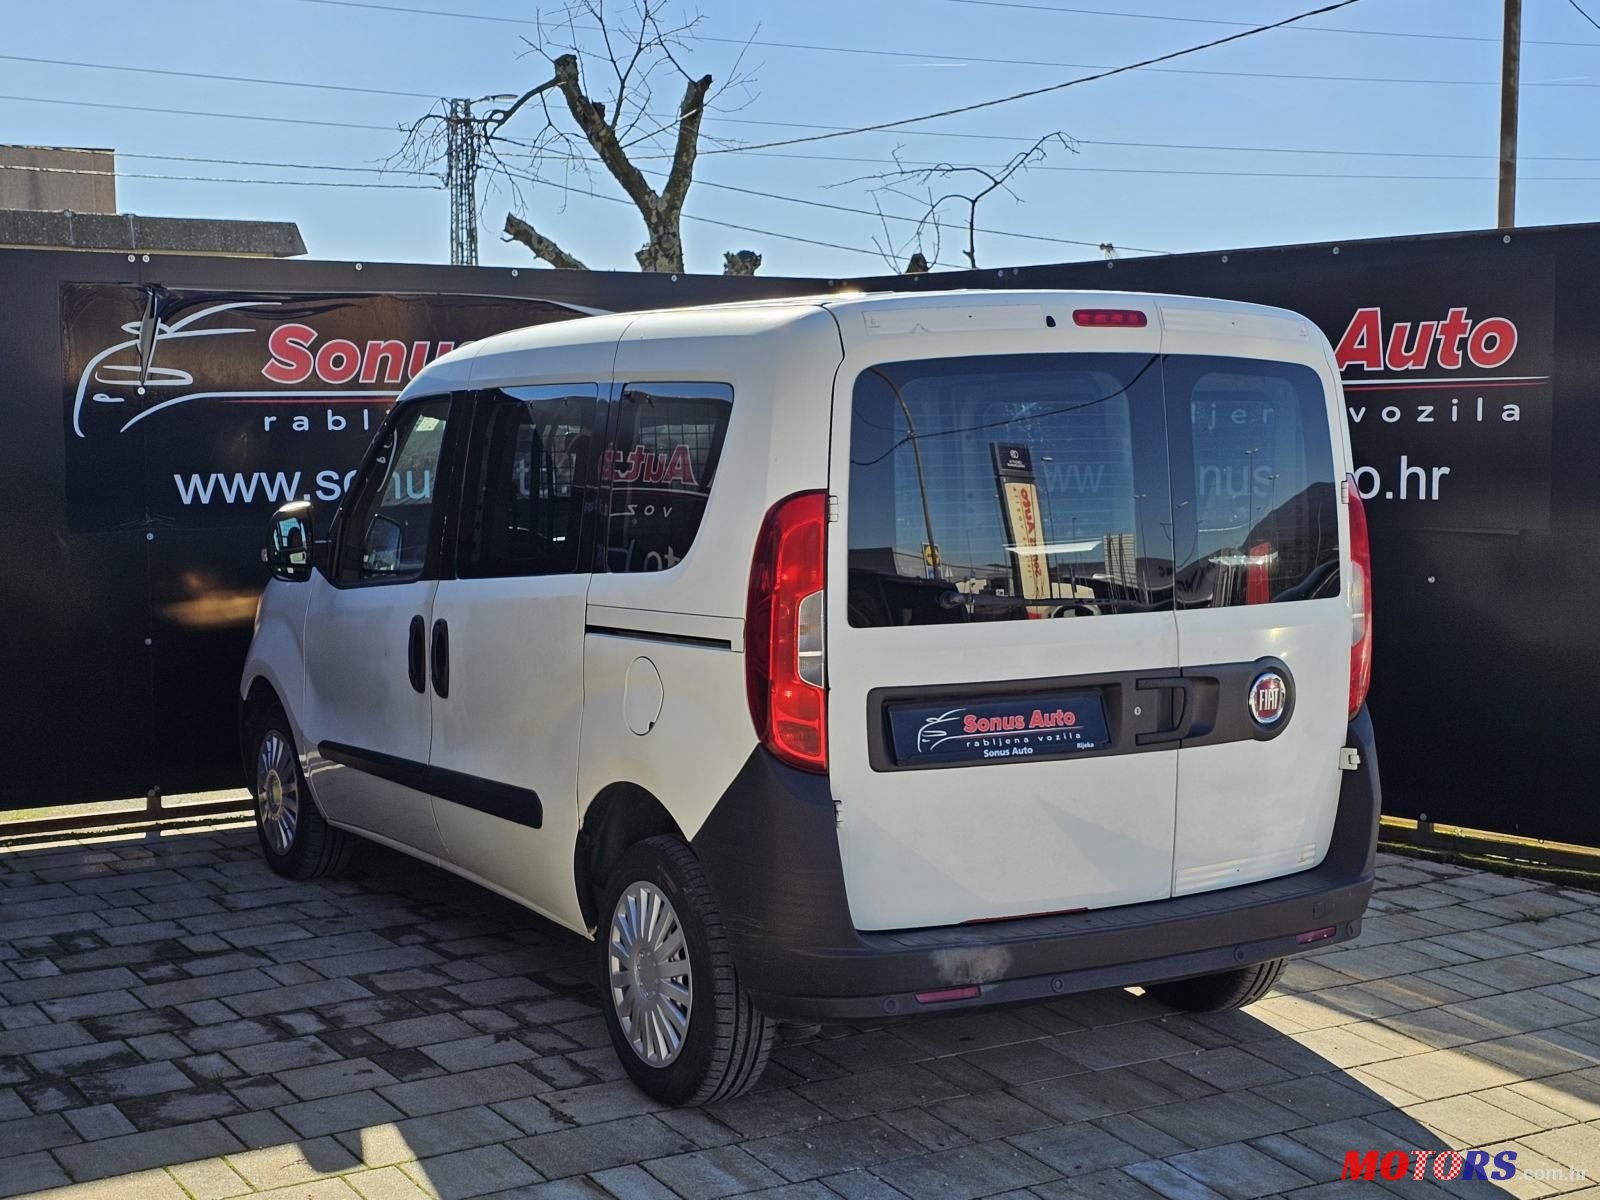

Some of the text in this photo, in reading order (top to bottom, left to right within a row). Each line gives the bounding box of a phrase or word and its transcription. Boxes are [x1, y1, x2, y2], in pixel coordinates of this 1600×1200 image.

[1333, 307, 1518, 371] Auto
[261, 323, 477, 384] Sonu
[264, 409, 391, 431] rabl
[1349, 397, 1521, 423] vozila
[1259, 687, 1279, 711] FIAT
[963, 709, 1076, 733] Sonus Auto
[1037, 732, 1081, 743] vozila
[983, 746, 1033, 758] Sonus Auto
